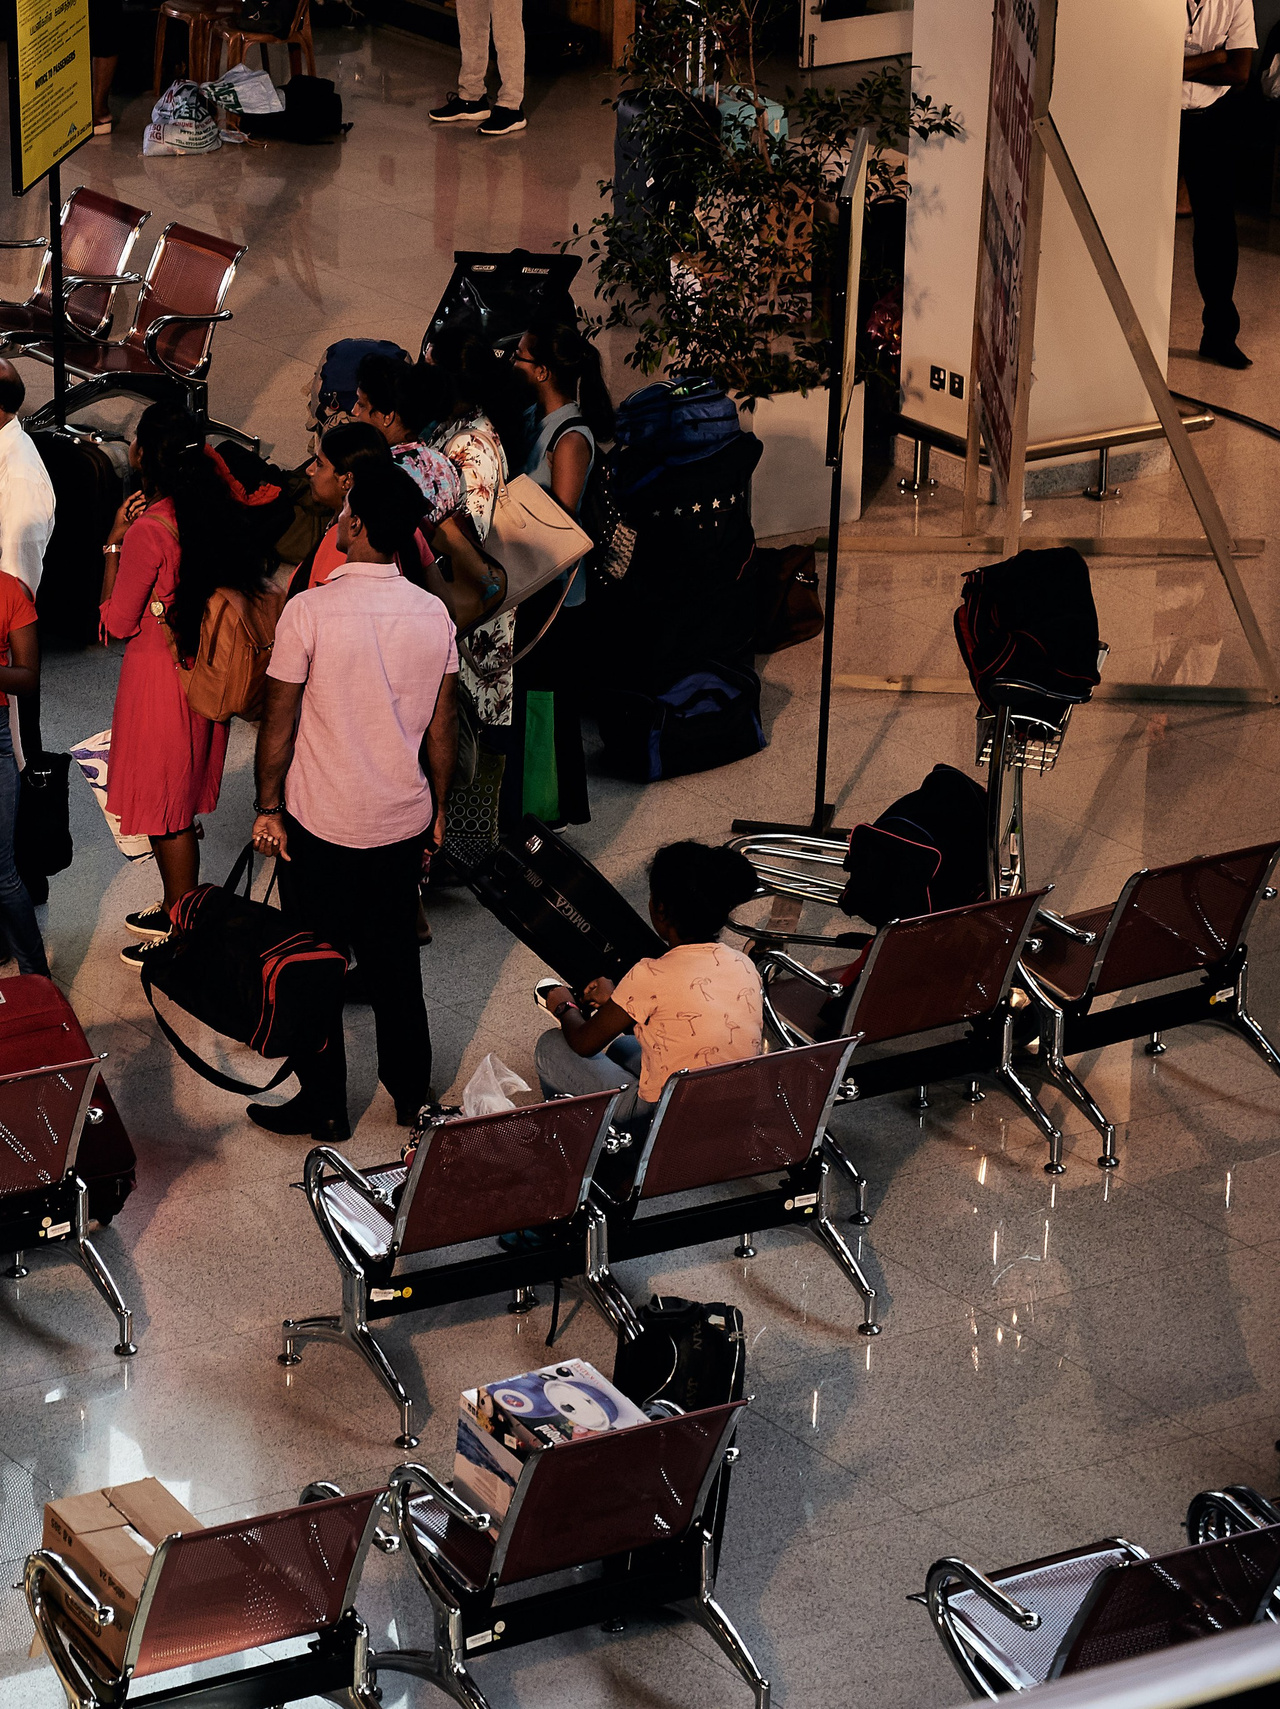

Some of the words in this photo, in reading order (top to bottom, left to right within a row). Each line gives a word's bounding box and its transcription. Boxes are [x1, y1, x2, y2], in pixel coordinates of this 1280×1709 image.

[34, 72, 48, 90] NOTICE
[53, 50, 76, 76] PASSENGERS
[149, 131, 162, 140] KG
[555, 894, 591, 934] OMIGA
